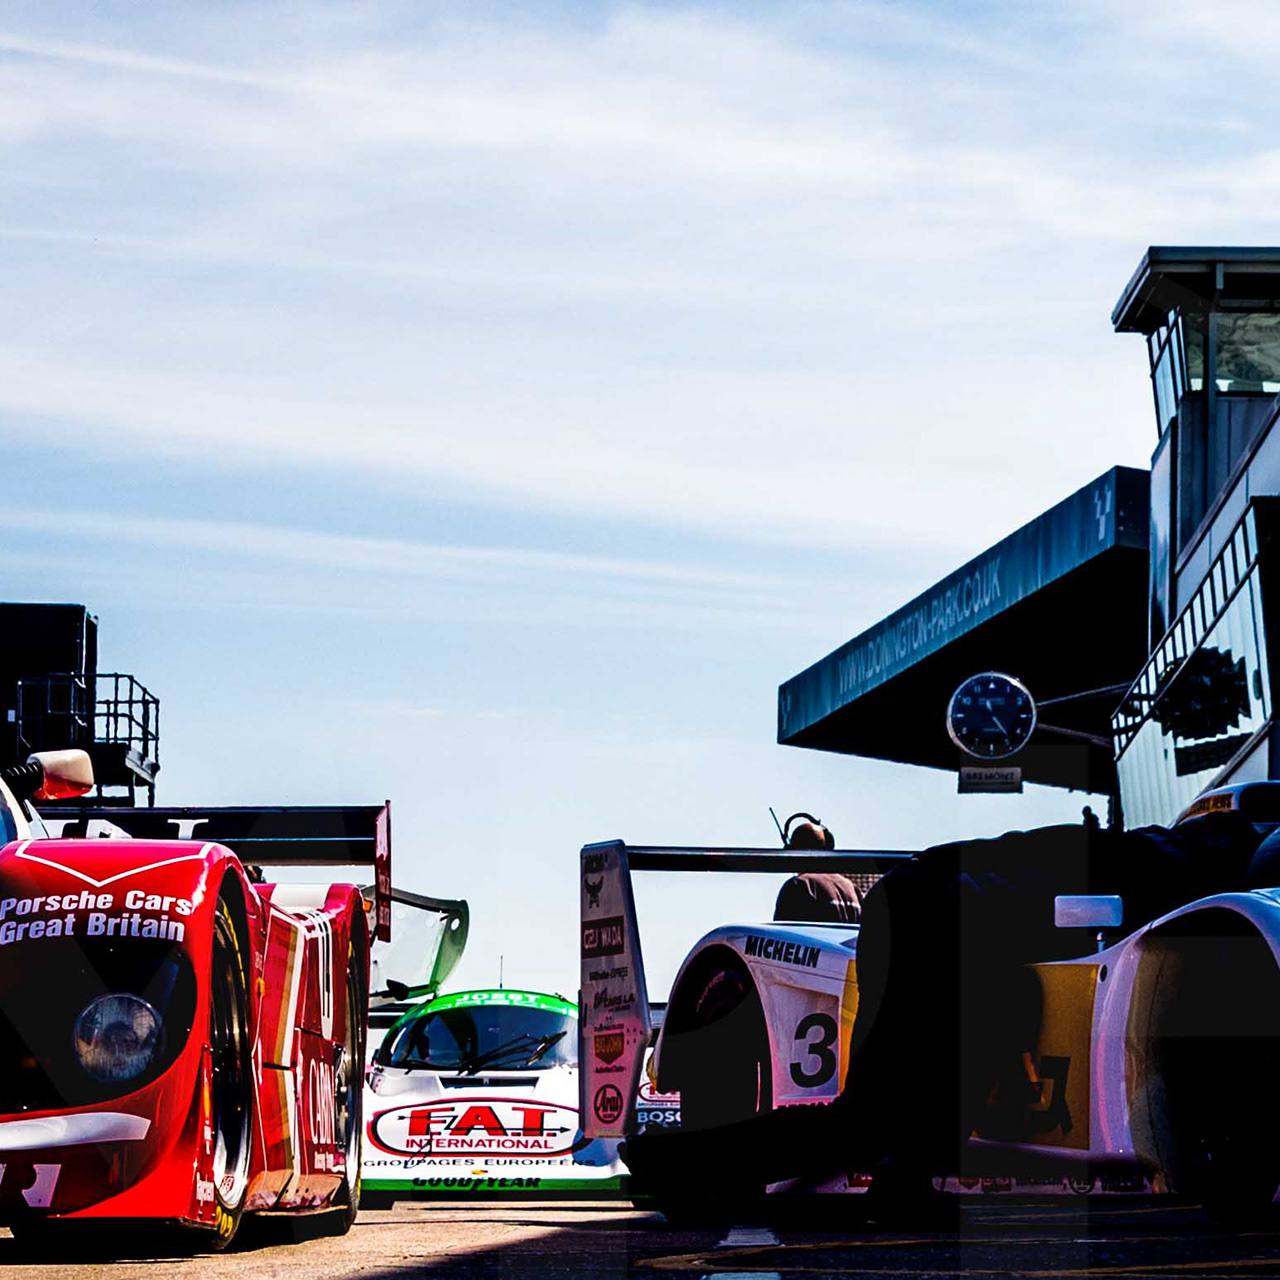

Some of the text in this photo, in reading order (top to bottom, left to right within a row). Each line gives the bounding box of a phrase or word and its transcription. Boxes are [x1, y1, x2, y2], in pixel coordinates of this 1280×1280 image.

[125, 889, 193, 916] Cars
[86, 912, 185, 943] Britain
[744, 934, 822, 969] MICHELIN
[405, 1138, 555, 1150] INTERNATIONAL
[363, 1158, 475, 1168] GROUPAGES
